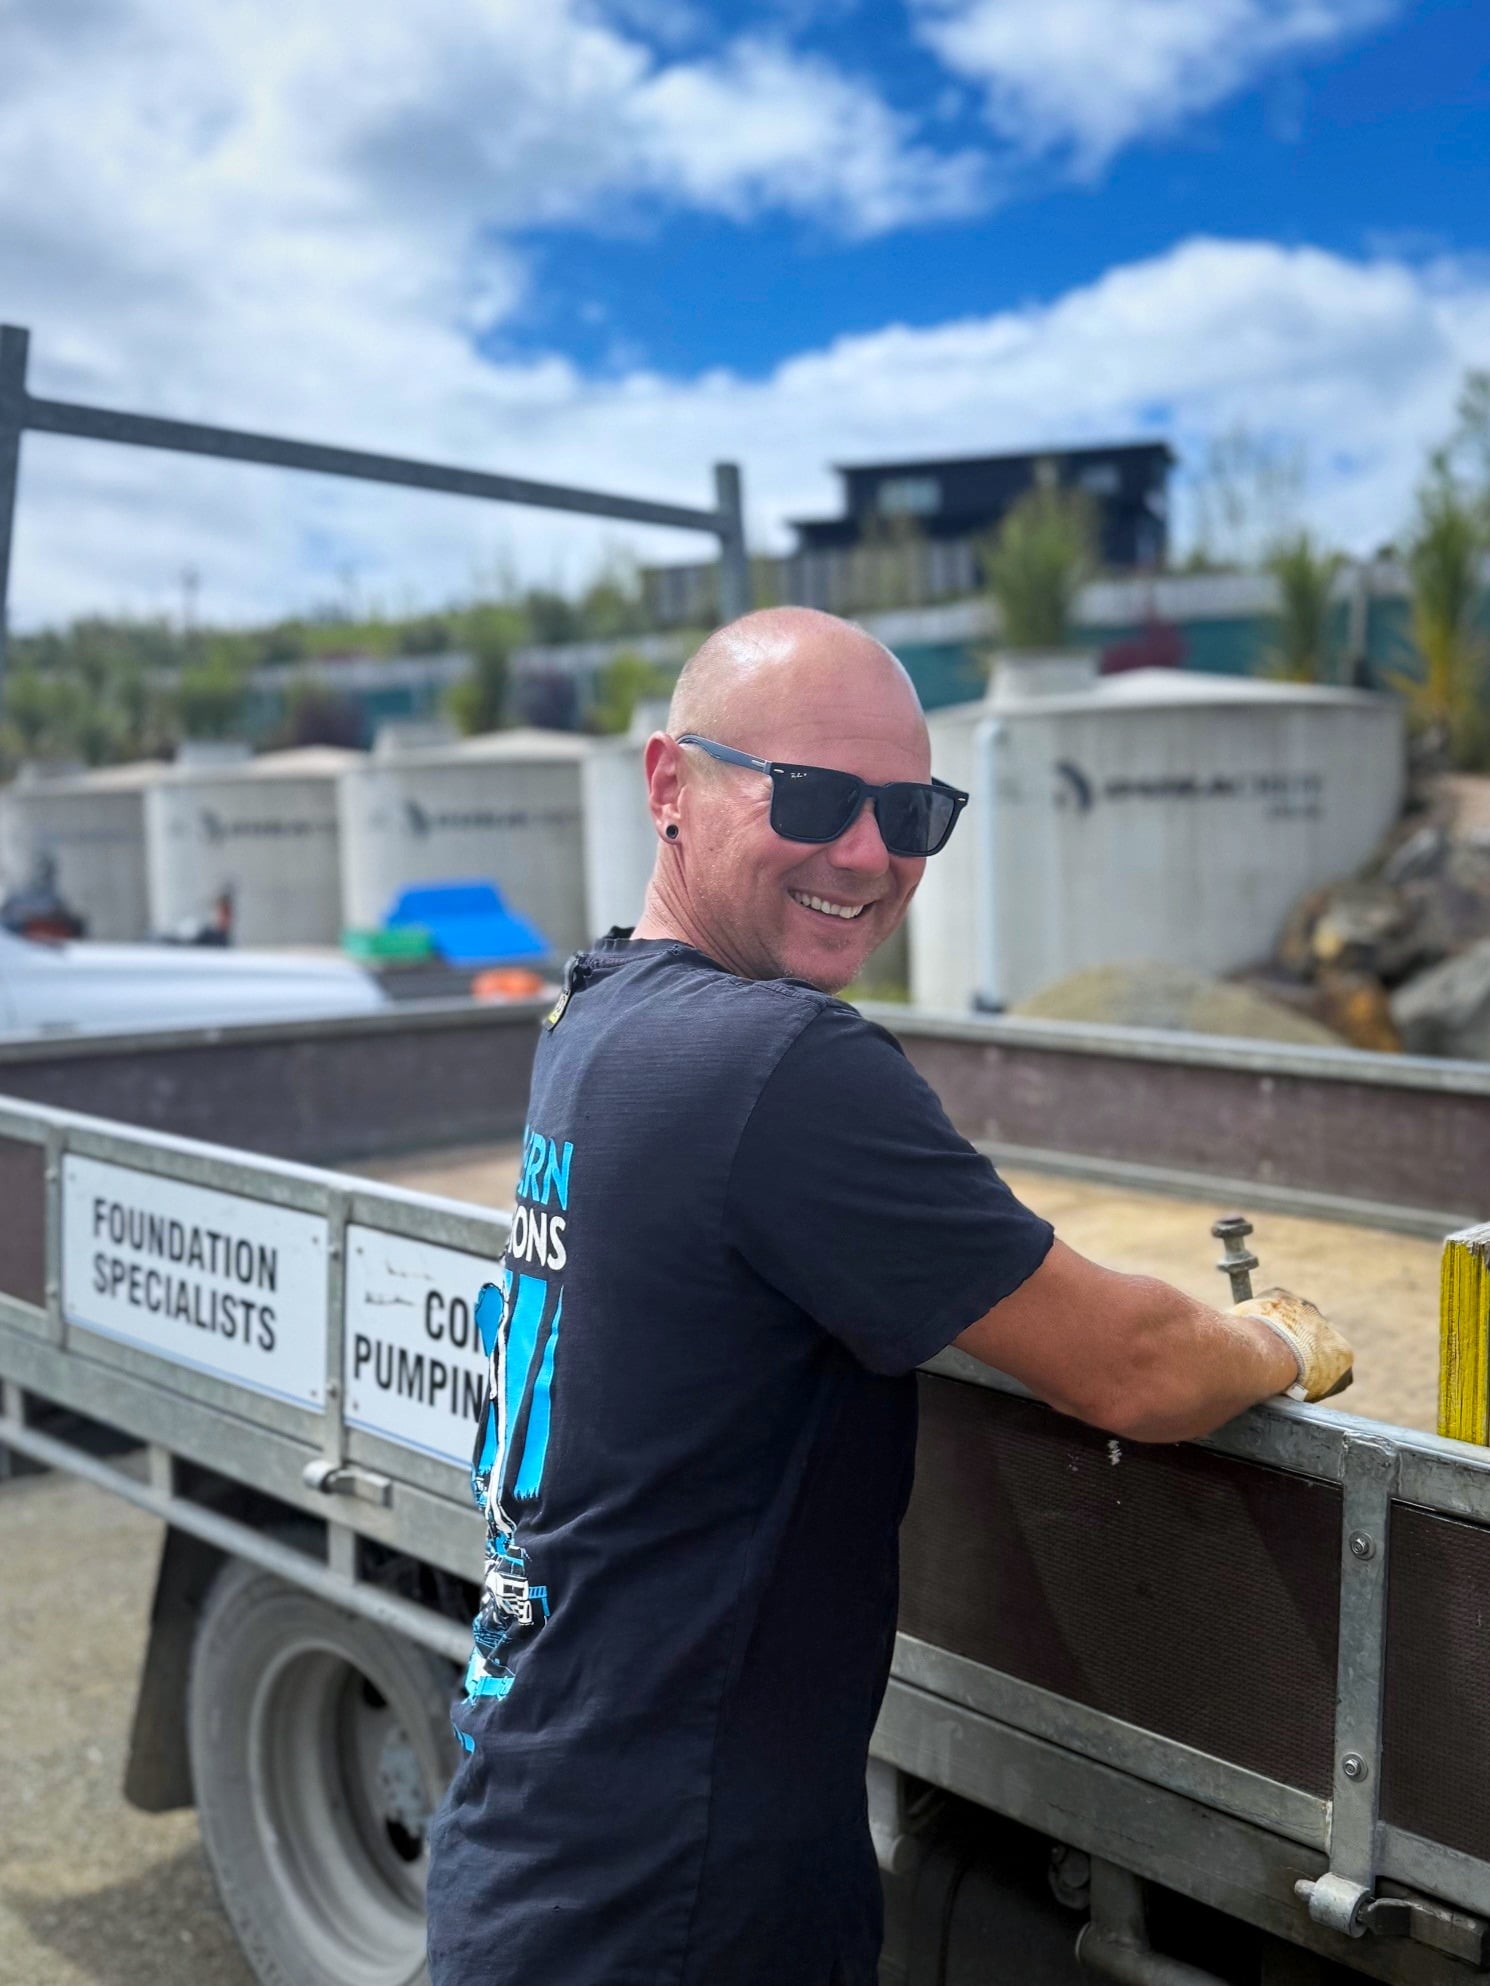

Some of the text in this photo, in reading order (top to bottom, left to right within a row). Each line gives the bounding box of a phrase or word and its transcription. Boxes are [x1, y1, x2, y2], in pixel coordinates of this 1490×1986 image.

[517, 1124, 574, 1211] RN
[94, 1197, 278, 1292] FOUNDATION
[508, 1205, 567, 1271] ONS
[93, 1252, 276, 1353] SPECIALISTS
[354, 1333, 484, 1424] PUMPIN
